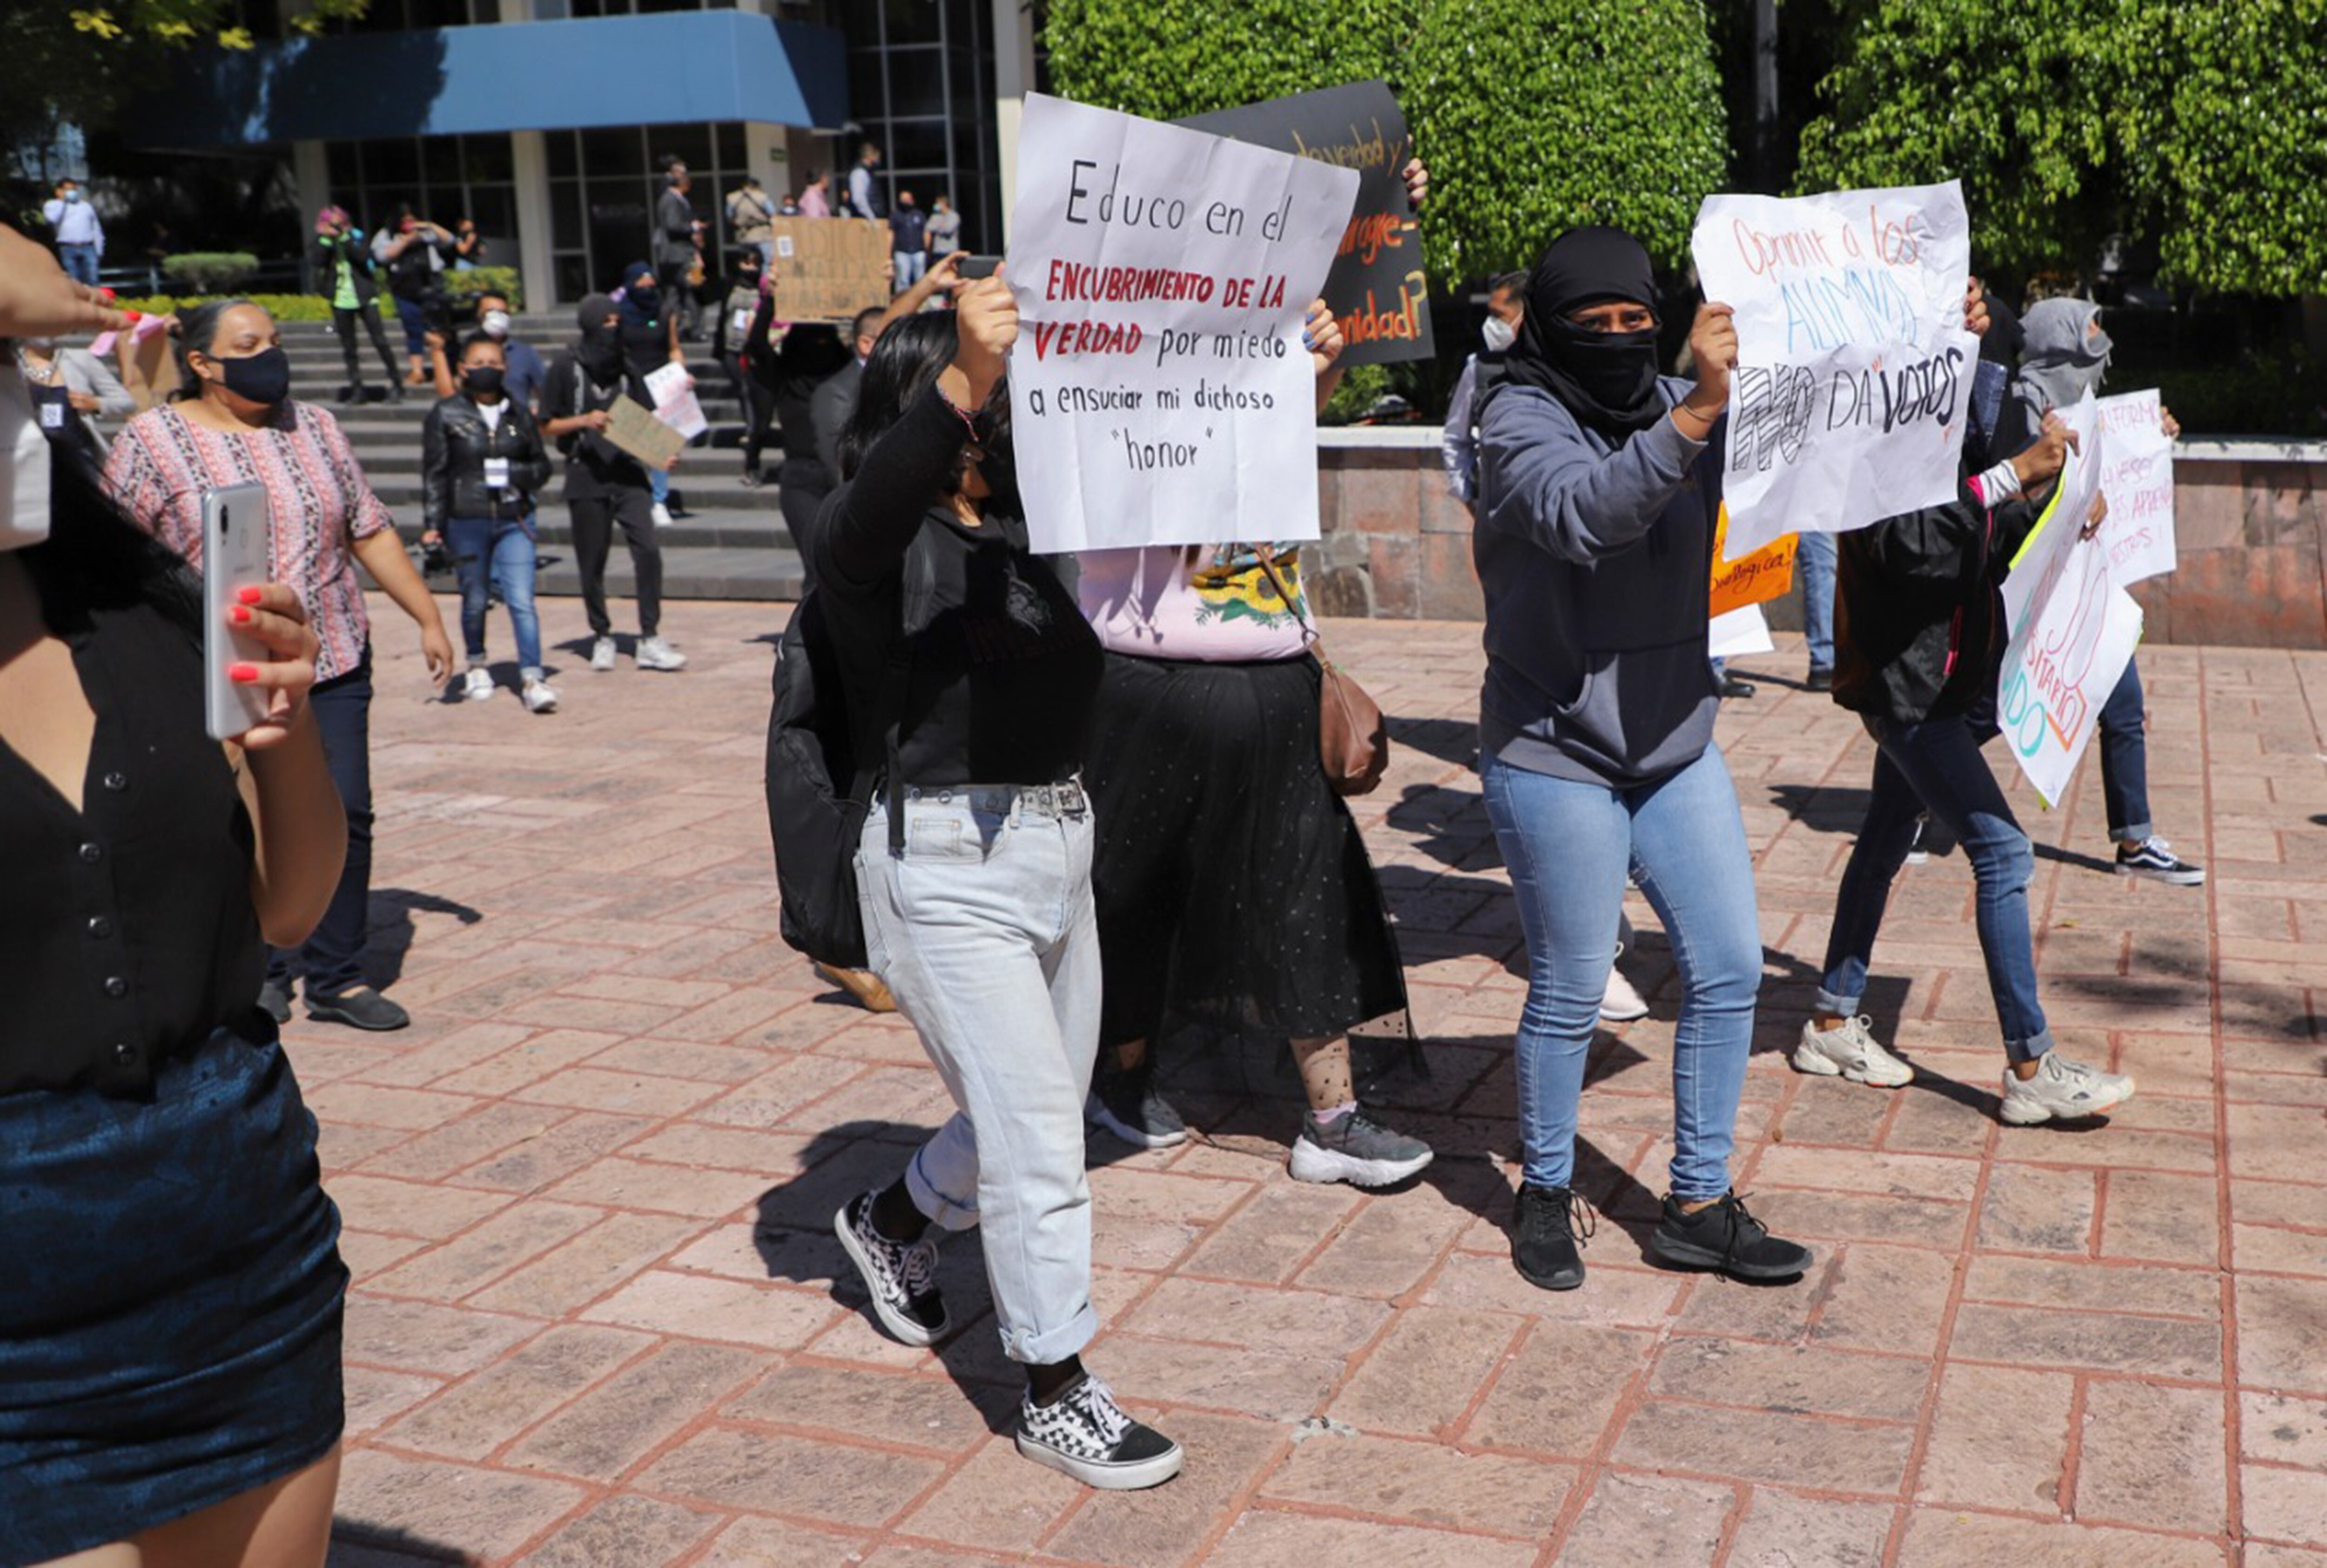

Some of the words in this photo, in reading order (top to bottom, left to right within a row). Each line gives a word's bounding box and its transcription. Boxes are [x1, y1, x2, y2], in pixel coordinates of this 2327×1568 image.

[1066, 159, 1185, 230] Educo
[1205, 200, 1244, 237] en
[1262, 194, 1293, 242] el
[1870, 204, 1919, 266] los
[1045, 259, 1214, 303] ENCUBRIMIENTO
[1222, 276, 1255, 309] DE
[1259, 275, 1287, 309] LA
[1034, 320, 1143, 362] VERDAD
[1156, 327, 1201, 367] por
[1213, 328, 1287, 360] miedo
[1029, 387, 1046, 417] a
[1056, 383, 1143, 414] ensuciar
[1156, 387, 1181, 409] mi
[1194, 377, 1275, 410] dichoso
[1111, 427, 1214, 470] "honor"
